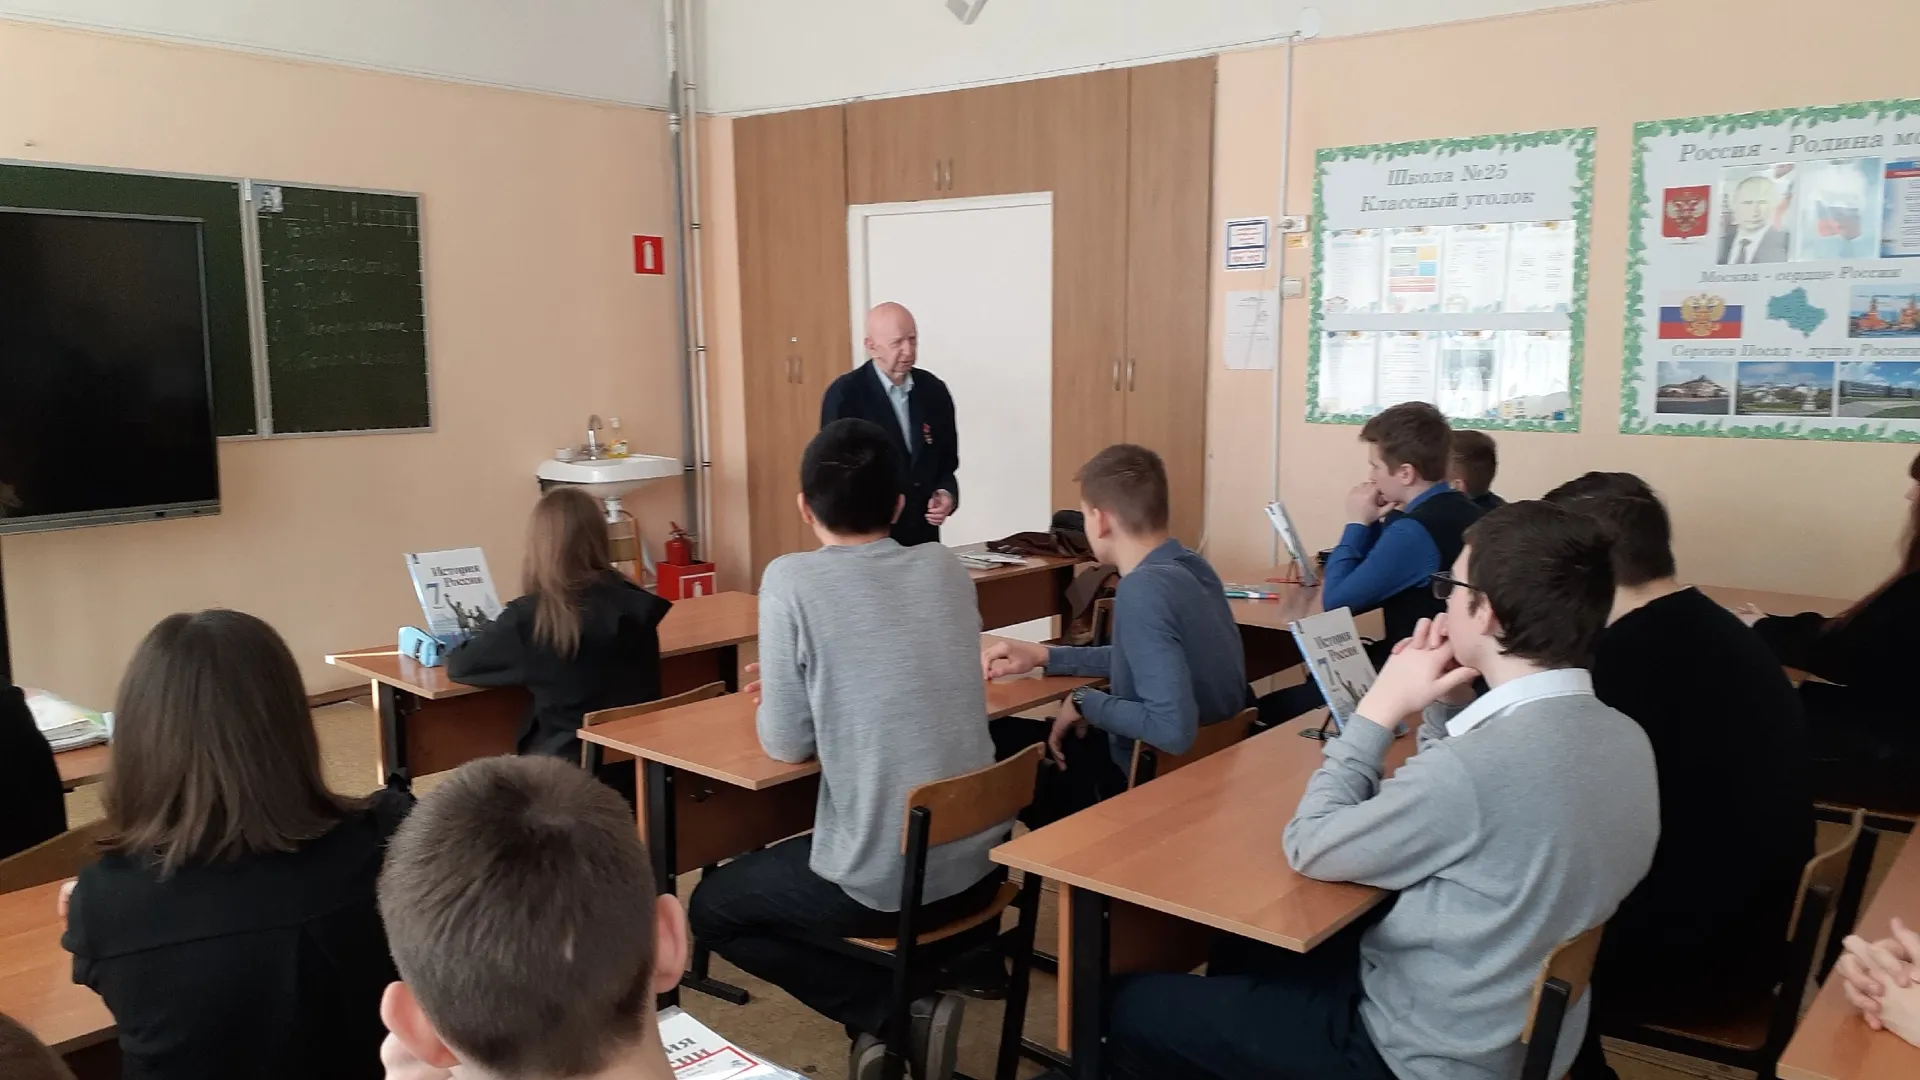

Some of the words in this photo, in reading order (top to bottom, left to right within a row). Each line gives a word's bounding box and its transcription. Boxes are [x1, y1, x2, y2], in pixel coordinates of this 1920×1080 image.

[1678, 143, 1762, 163] Россия
[1785, 134, 1884, 155] Родина
[1386, 168, 1454, 186] Школа
[1460, 163, 1508, 182] №25
[1360, 192, 1459, 212] Классный
[1462, 191, 1536, 210] уголок
[1699, 270, 1760, 283] Москва
[1838, 266, 1902, 280] России
[1671, 344, 1737, 359] Сергиев
[1740, 343, 1793, 358] Посад
[430, 565, 481, 577] История
[426, 582, 440, 606] 7
[1317, 657, 1336, 687] 7
